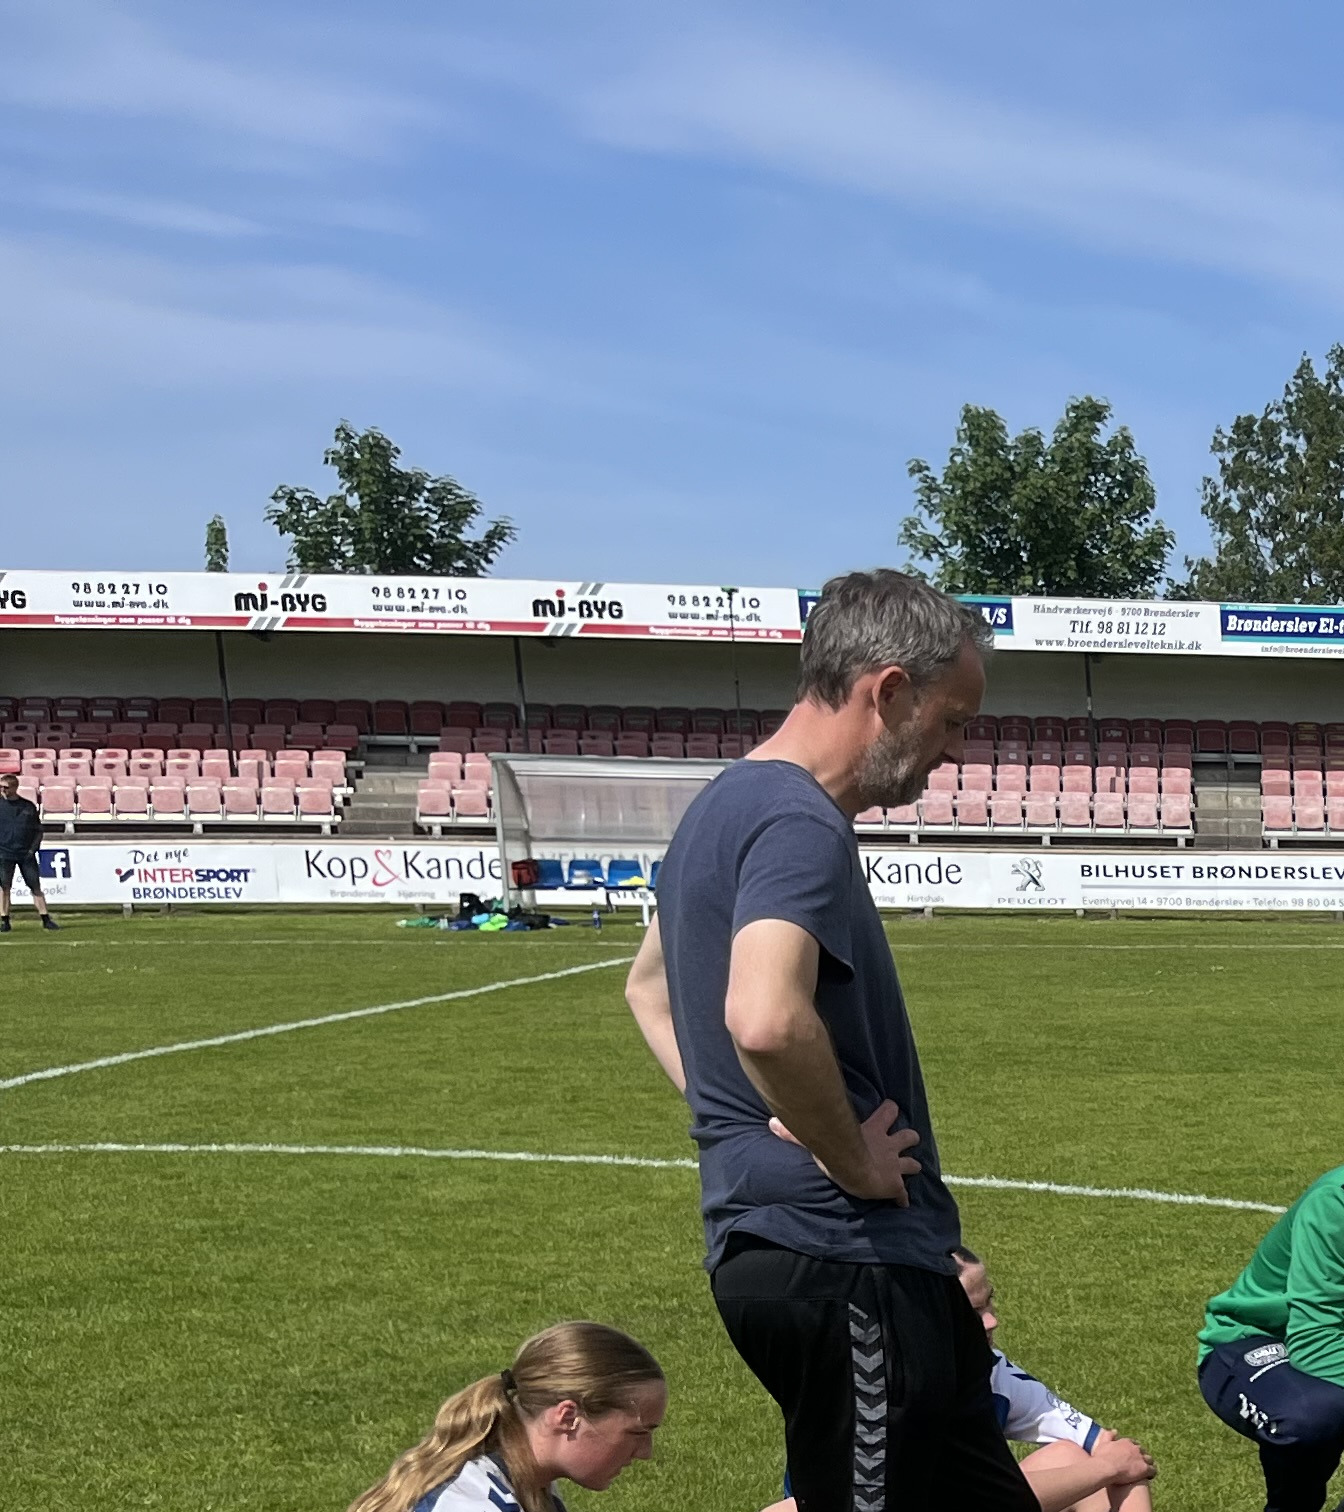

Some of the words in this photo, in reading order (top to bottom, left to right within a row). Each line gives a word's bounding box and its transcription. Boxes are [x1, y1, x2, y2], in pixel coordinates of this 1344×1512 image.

[71, 582, 92, 595] 98
[97, 583, 117, 595] 82
[121, 583, 141, 595] 27
[149, 583, 168, 595] 10
[371, 586, 391, 599] 98
[396, 587, 416, 599] 82
[421, 588, 440, 600] 27
[447, 589, 468, 600] 10
[667, 594, 686, 607] 98
[691, 596, 710, 608] 82
[740, 597, 761, 610] 10
[1120, 607, 1142, 617] 9700
[1143, 607, 1201, 619] Brønderslev
[1069, 620, 1093, 634] Tlf.
[1097, 620, 1112, 634] 98
[1116, 621, 1131, 634] 81
[1134, 622, 1149, 635] 12
[1151, 622, 1166, 636] 12
[1226, 614, 1317, 634] Brønderslev
[129, 849, 159, 865] Det
[164, 847, 190, 864] nye
[138, 868, 250, 883] INTERSPORT
[1080, 864, 1185, 878] BILHUSET
[132, 886, 243, 900] BRØNDERSLEV
[997, 897, 1067, 906] PEUGEOT
[1156, 897, 1183, 907] 9700
[1252, 897, 1289, 908] Telefon
[1291, 898, 1305, 908] 98
[1322, 898, 1336, 908] 04
